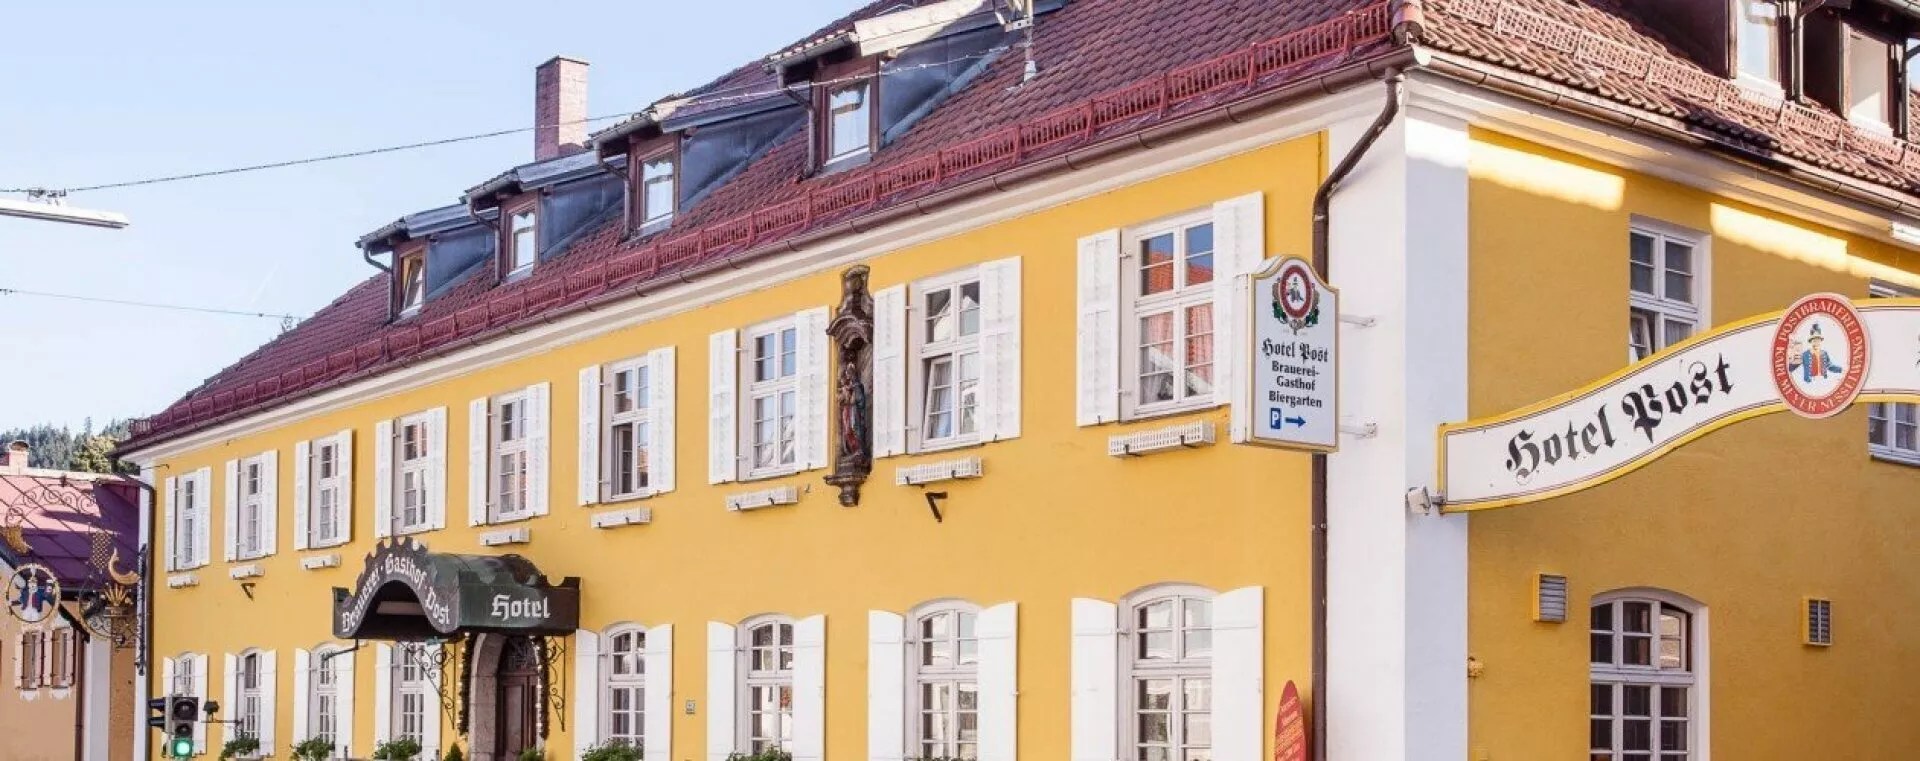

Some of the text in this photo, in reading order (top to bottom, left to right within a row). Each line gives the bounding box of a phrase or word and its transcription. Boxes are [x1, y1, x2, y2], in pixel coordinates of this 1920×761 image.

[1779, 300, 1860, 342] POSTBRAUEREI
[1262, 338, 1328, 364] Hotel Post
[1271, 360, 1320, 377] Brauerei-
[1774, 336, 1863, 411] KARL MEYER NESSELWANG
[1276, 375, 1316, 391] Gasthof
[1268, 390, 1322, 408] Biergarten
[1506, 352, 1735, 486] Hotel Post
[342, 553, 451, 633] Brauerei Gasthof Post
[491, 594, 551, 621] Hotel
